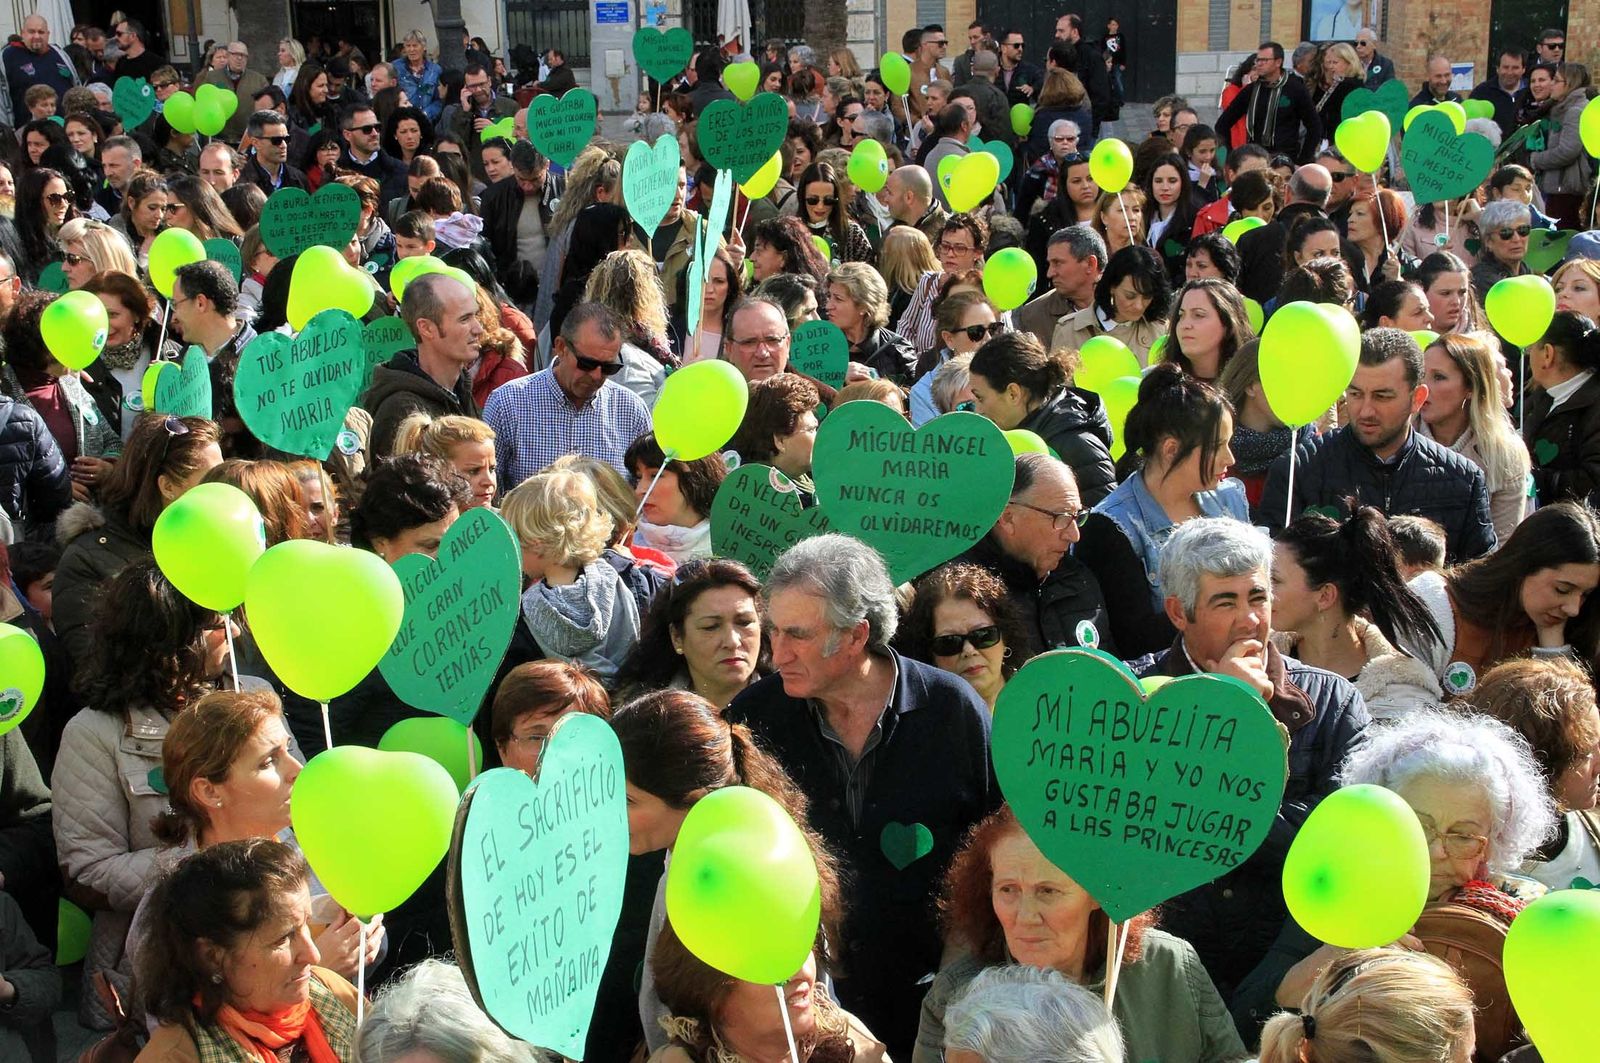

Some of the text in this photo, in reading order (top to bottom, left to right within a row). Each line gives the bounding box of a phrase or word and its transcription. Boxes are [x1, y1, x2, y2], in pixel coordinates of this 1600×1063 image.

[536, 99, 584, 117] ME GUSTABA
[536, 116, 562, 129] MUCHO
[708, 100, 783, 130] ERES LA NIÑA
[540, 131, 554, 140] CON
[557, 128, 566, 136] MI
[548, 140, 575, 154] CHARI
[716, 122, 782, 142] DE LOS OJOS
[1422, 122, 1465, 154] MIGUEL
[628, 152, 648, 177] NADA
[708, 146, 721, 156] DE
[1405, 149, 1464, 183] EL MEJOR
[1434, 146, 1474, 172] ANGEL
[632, 166, 676, 202] DETENERNOS
[270, 202, 279, 210] LA
[283, 197, 310, 209] BURLA
[274, 214, 282, 222] AL
[320, 210, 345, 219] HASTA
[658, 196, 665, 206] EL
[270, 228, 284, 238] QUE
[290, 226, 298, 235] EL
[302, 222, 338, 234] RESPETO
[294, 233, 325, 244] BASTA
[361, 328, 403, 344] PASADO
[806, 342, 830, 356] SER
[256, 350, 284, 376] TUS
[802, 360, 824, 372] POR
[256, 388, 275, 413] NO
[280, 379, 295, 397] TE
[302, 358, 353, 388] OLVIDAN
[846, 426, 988, 457] MIGUEL ANGEL
[736, 474, 749, 492] A
[808, 511, 830, 532] LA
[838, 484, 941, 507] NUNCA OS
[728, 496, 750, 517] DA
[760, 513, 780, 532] UN
[860, 512, 982, 542] OLVIDAREMOS
[450, 516, 490, 562] ANGEL
[720, 537, 738, 554] LA
[730, 516, 784, 556] INESPE
[390, 576, 466, 658] QUE GRAN
[1032, 684, 1238, 754] MI ABUELITA
[1145, 758, 1160, 782] Y
[1174, 760, 1203, 789] YO
[1218, 772, 1267, 803] NOS
[480, 752, 616, 883] EL SACRIFICIO
[1045, 778, 1252, 848] GUSTABA JUGAR
[1043, 810, 1246, 868] A LAS PRINCESAS
[482, 826, 602, 946] DE HOY ES EL
[576, 874, 598, 926] DE
[527, 944, 601, 1025] MAÑANA
